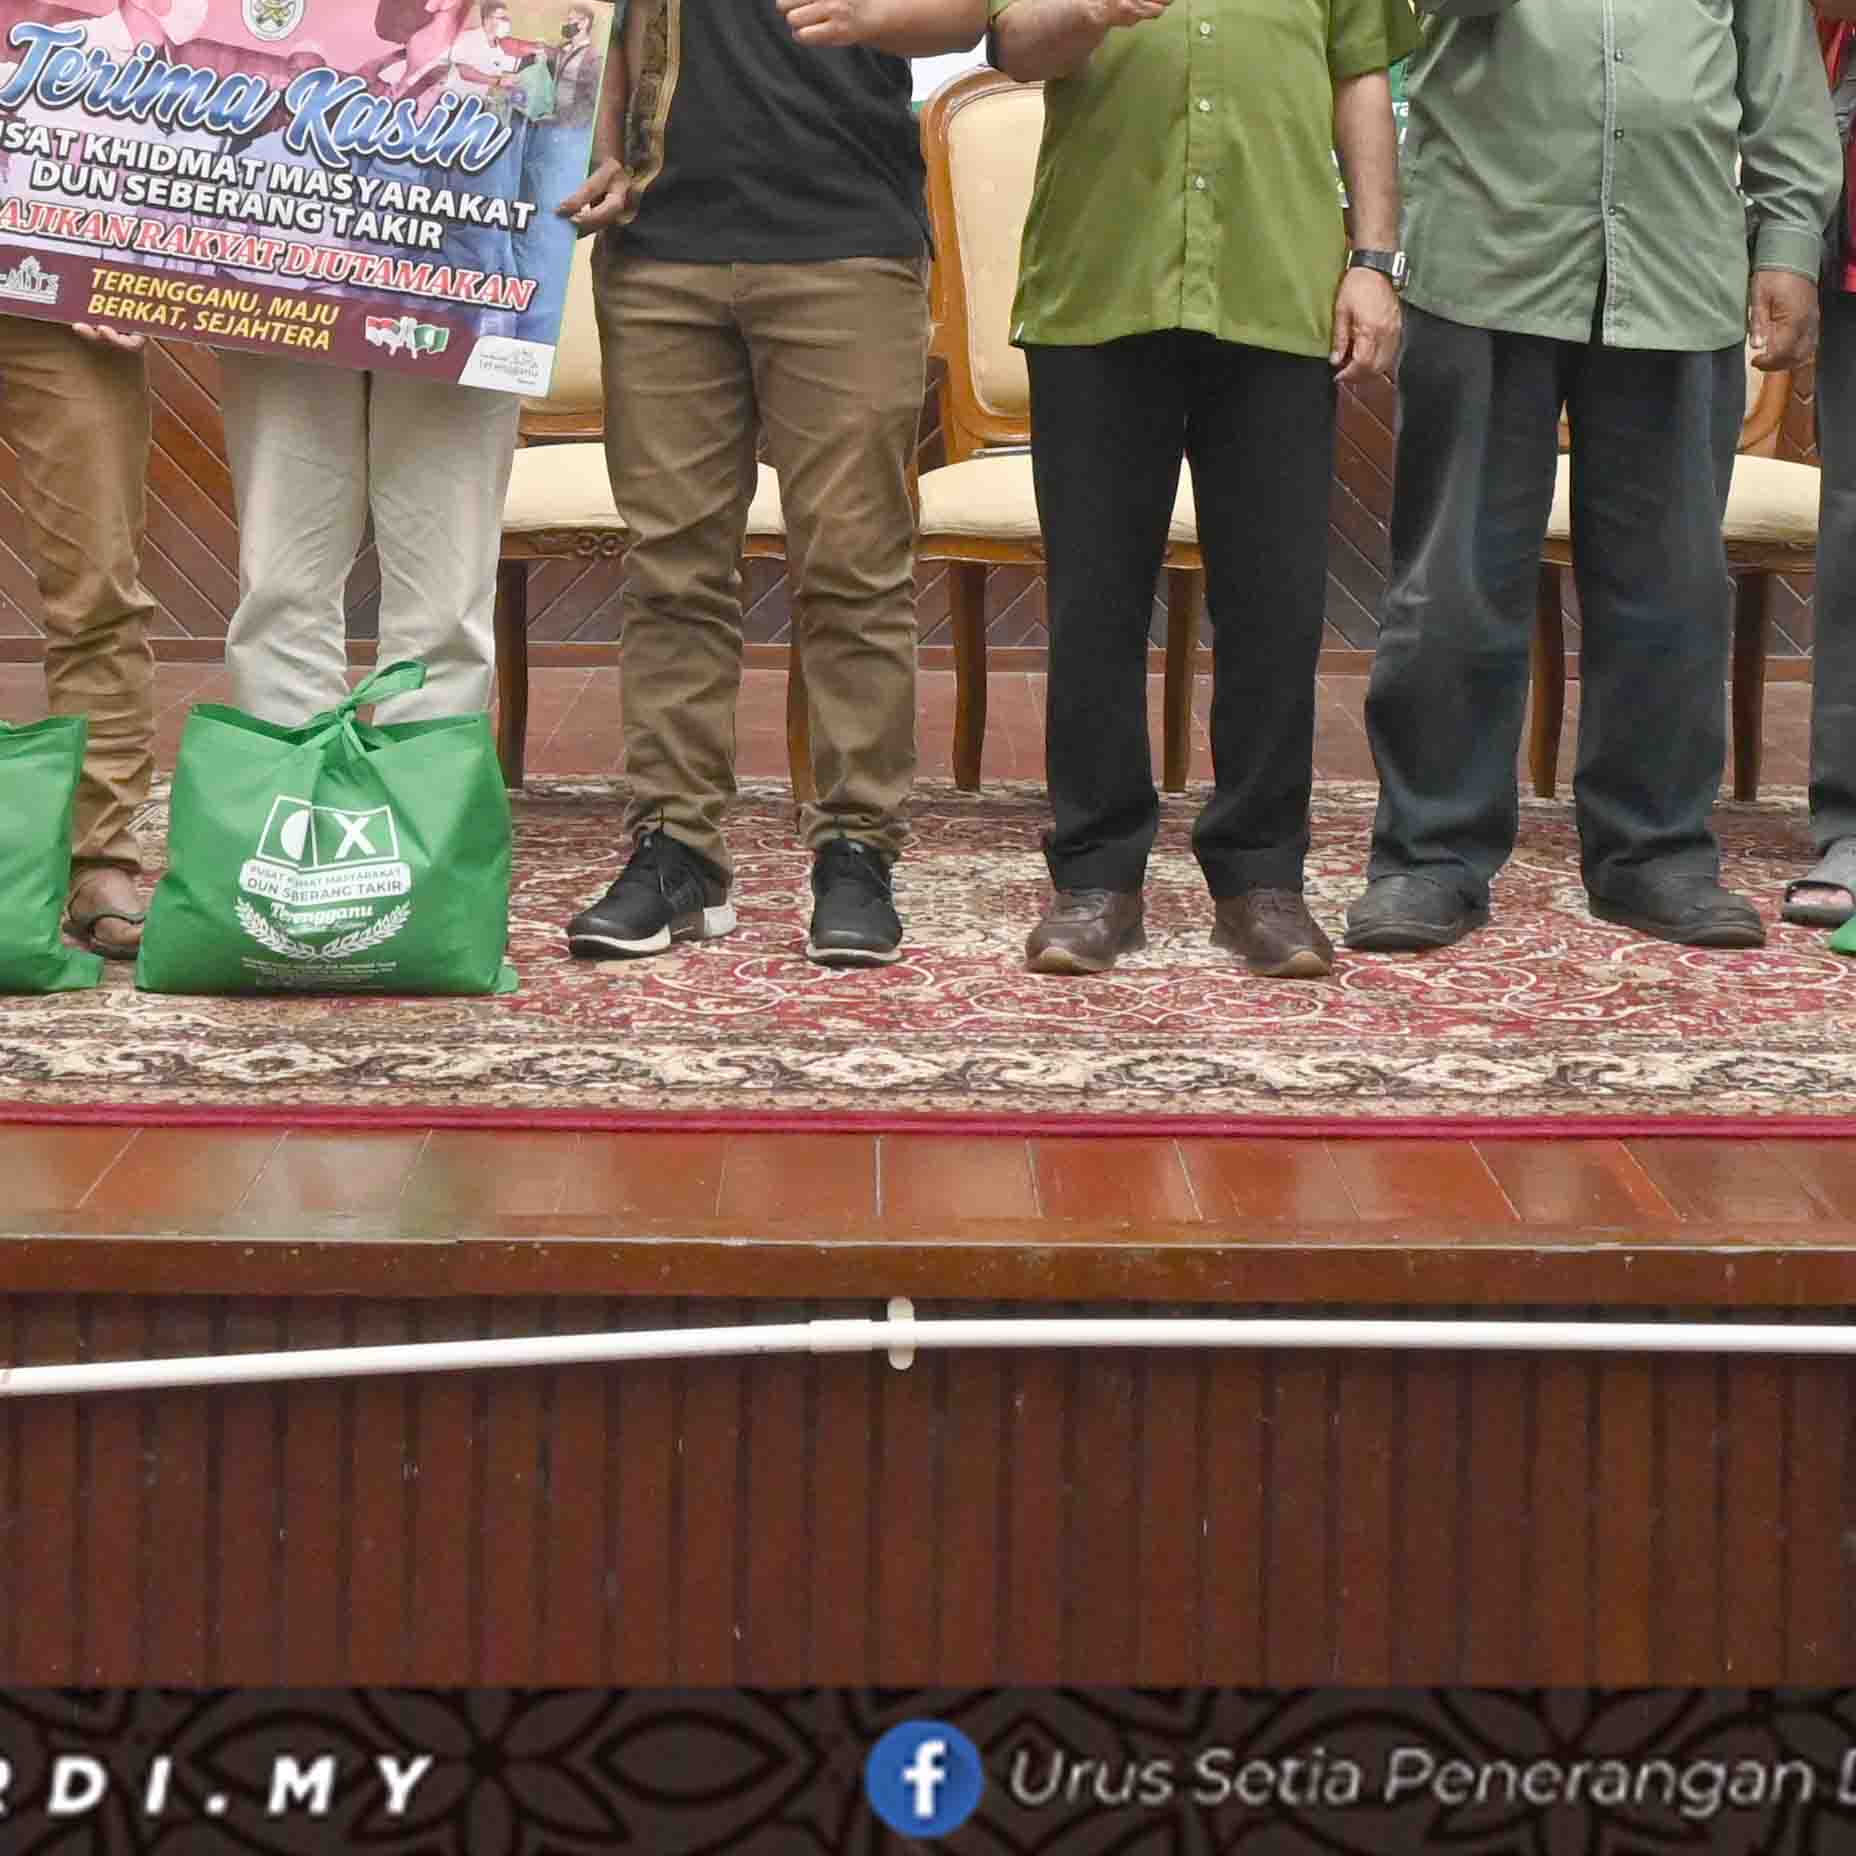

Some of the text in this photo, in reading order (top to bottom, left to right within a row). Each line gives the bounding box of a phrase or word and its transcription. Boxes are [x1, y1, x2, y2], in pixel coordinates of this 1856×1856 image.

[285, 68, 513, 171] Kasih
[31, 160, 444, 249] DUN SEBERANG TAKIR
[84, 134, 265, 191] KHIDMAT
[269, 163, 536, 230] MASYARAKAT
[91, 268, 262, 316] TERENGGANU,
[267, 295, 340, 325] MAJU
[134, 218, 286, 272] RAKYAT
[281, 240, 539, 311] DIUTAMAKAN
[87, 294, 188, 331] BERKAT,
[193, 310, 331, 351] SEJAHTERA
[247, 878, 279, 896] DUN
[358, 880, 402, 895] TAKIR
